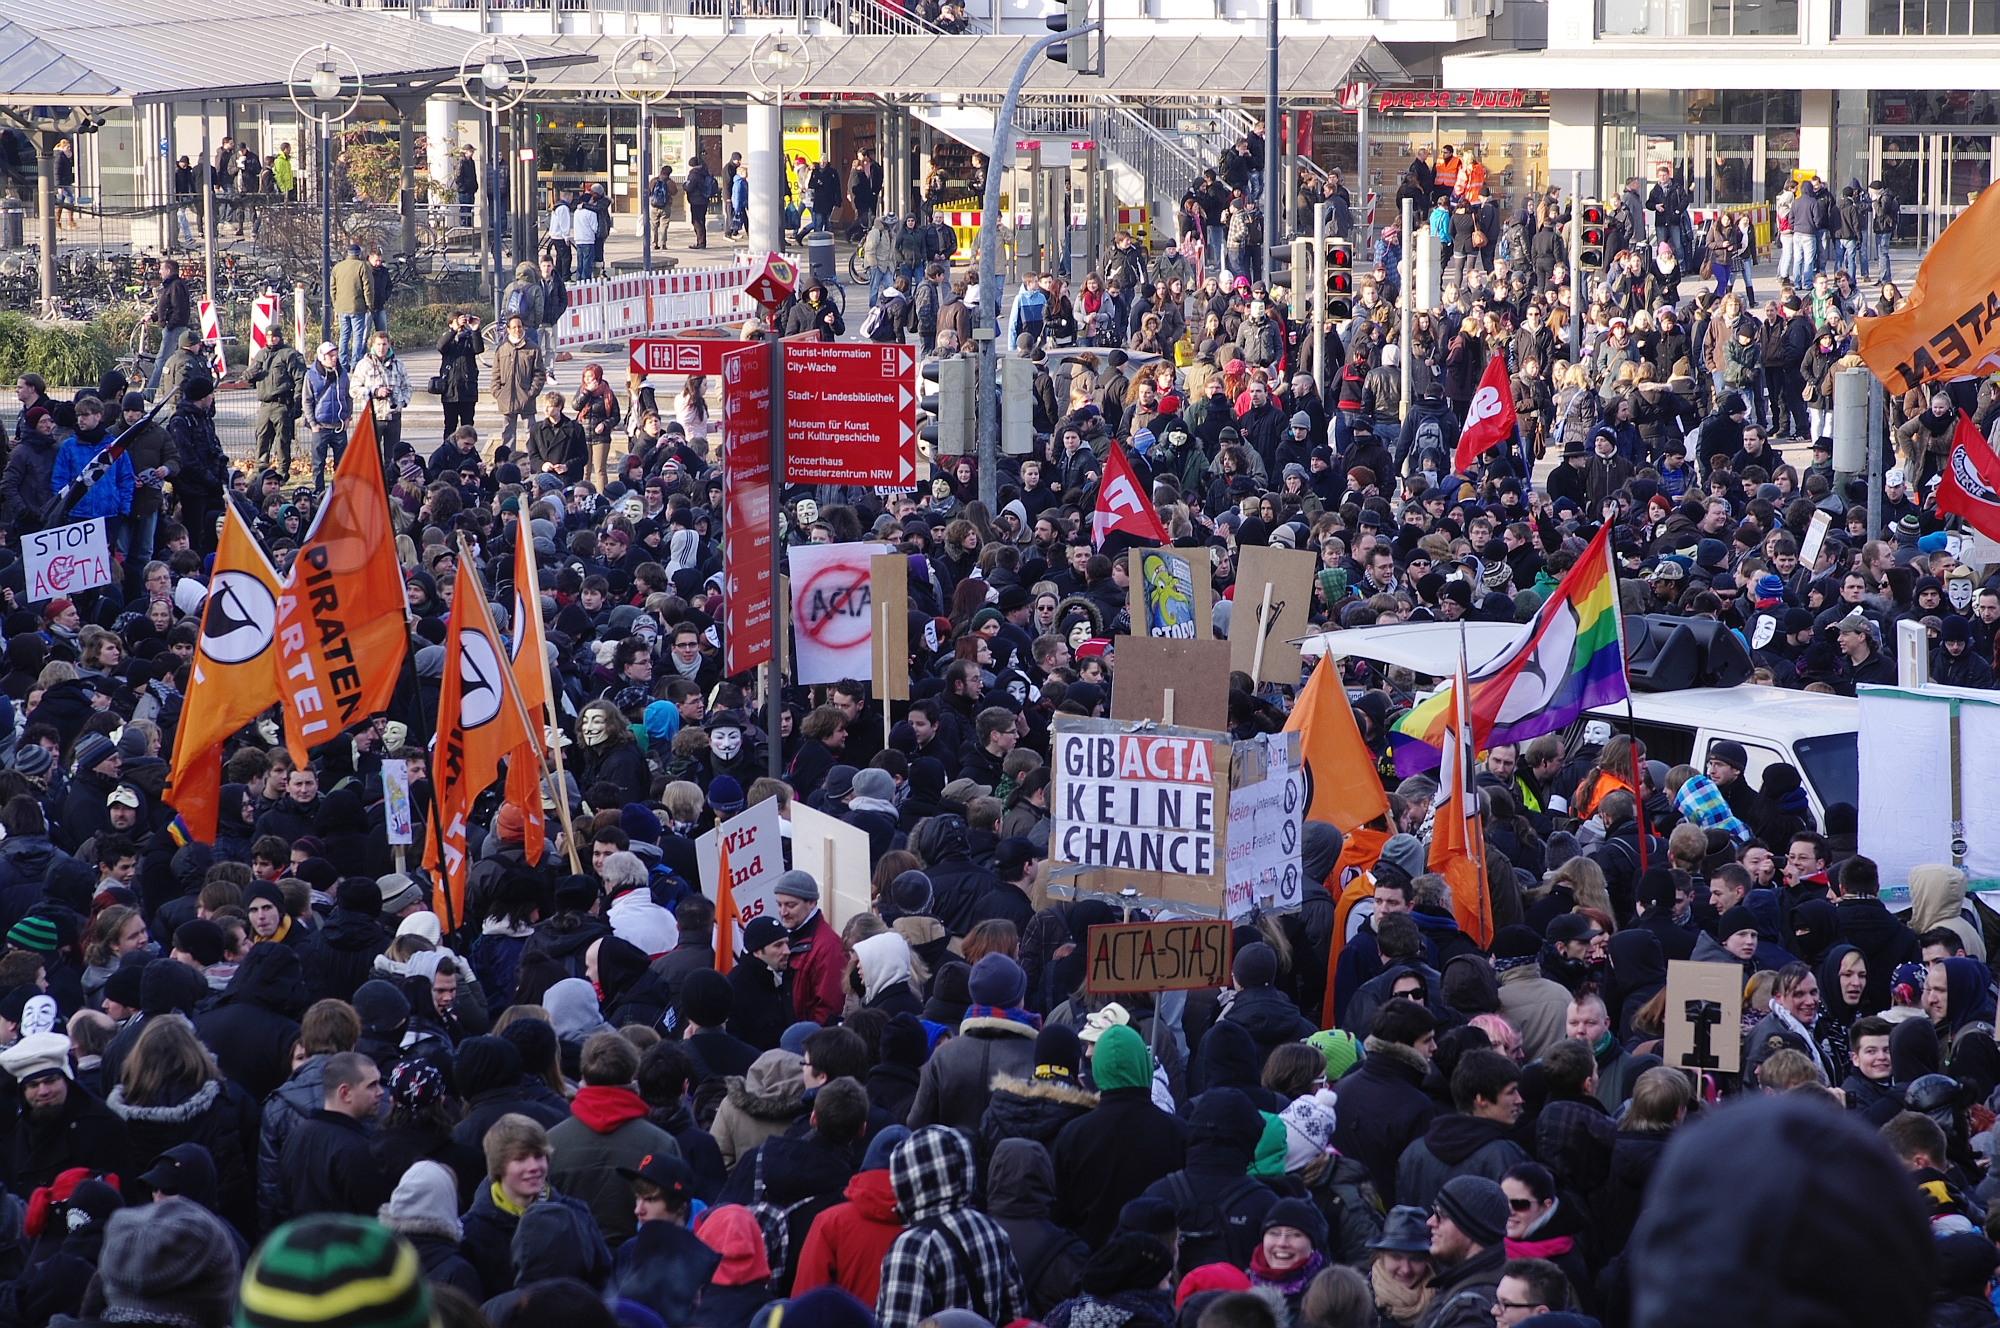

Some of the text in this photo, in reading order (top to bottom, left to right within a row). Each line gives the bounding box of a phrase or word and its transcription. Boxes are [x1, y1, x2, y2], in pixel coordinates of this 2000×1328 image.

[1378, 91, 1450, 112] presse
[1471, 88, 1523, 108] buch
[787, 347, 871, 359] Tourist-Information
[787, 362, 837, 373] City-Wache
[787, 390, 895, 403] Stadt-/ Landesbibliothek
[788, 419, 870, 431] Museum für Kunst
[788, 431, 880, 443] und Kulturgeschichte
[788, 455, 843, 466] Konzerthaus
[788, 467, 893, 479] Orchesterzentrum NRW
[34, 523, 95, 556] STOP
[35, 555, 108, 597] ACTA
[811, 585, 871, 622] ACTA
[304, 545, 363, 724] PIRATEN
[1065, 736, 1212, 782] GIB ACTA
[1067, 783, 1212, 831] KEINE
[1228, 802, 1250, 823] kein
[1063, 826, 1210, 875] CHANCE
[1226, 830, 1276, 863] keine Freiheit
[729, 855, 763, 888] ind
[742, 898, 764, 923] as
